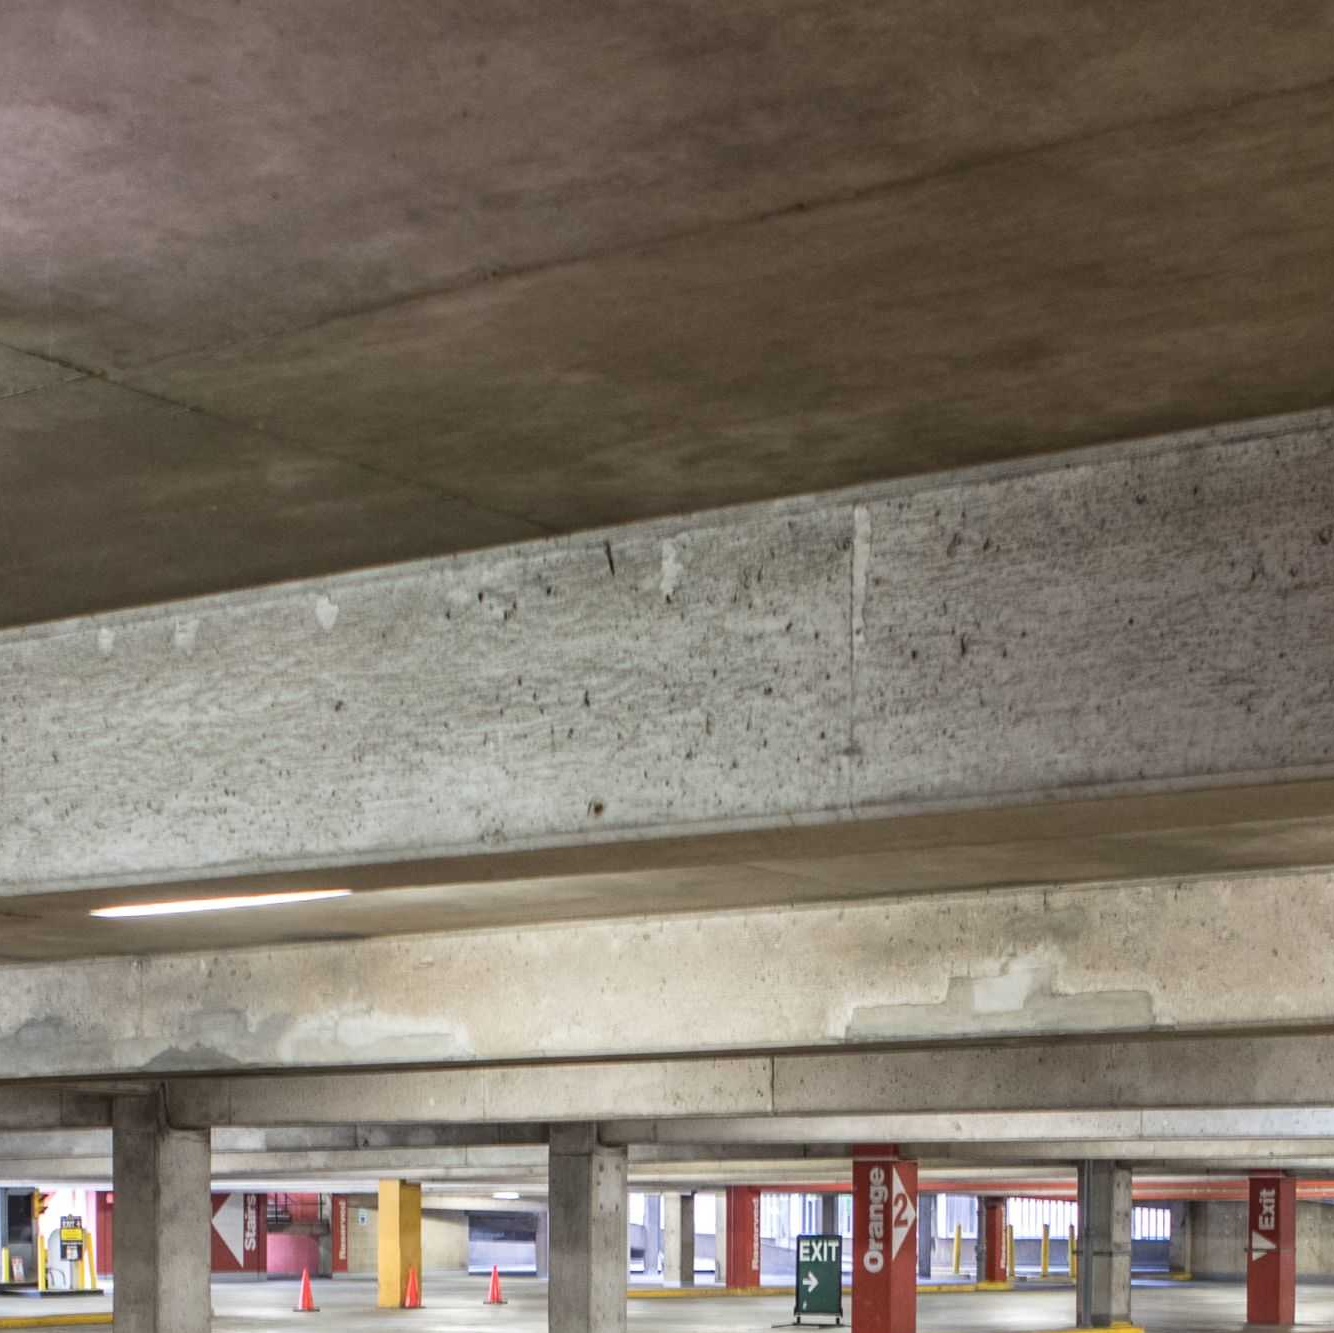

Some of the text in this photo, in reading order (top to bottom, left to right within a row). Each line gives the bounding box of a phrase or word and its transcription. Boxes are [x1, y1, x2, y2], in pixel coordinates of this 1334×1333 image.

[245, 1194, 257, 1251] Stairs
[863, 1167, 888, 1273] Orange
[893, 1193, 908, 1228] 2
[1259, 1189, 1275, 1230] Exit
[799, 1240, 840, 1262] EXIT
